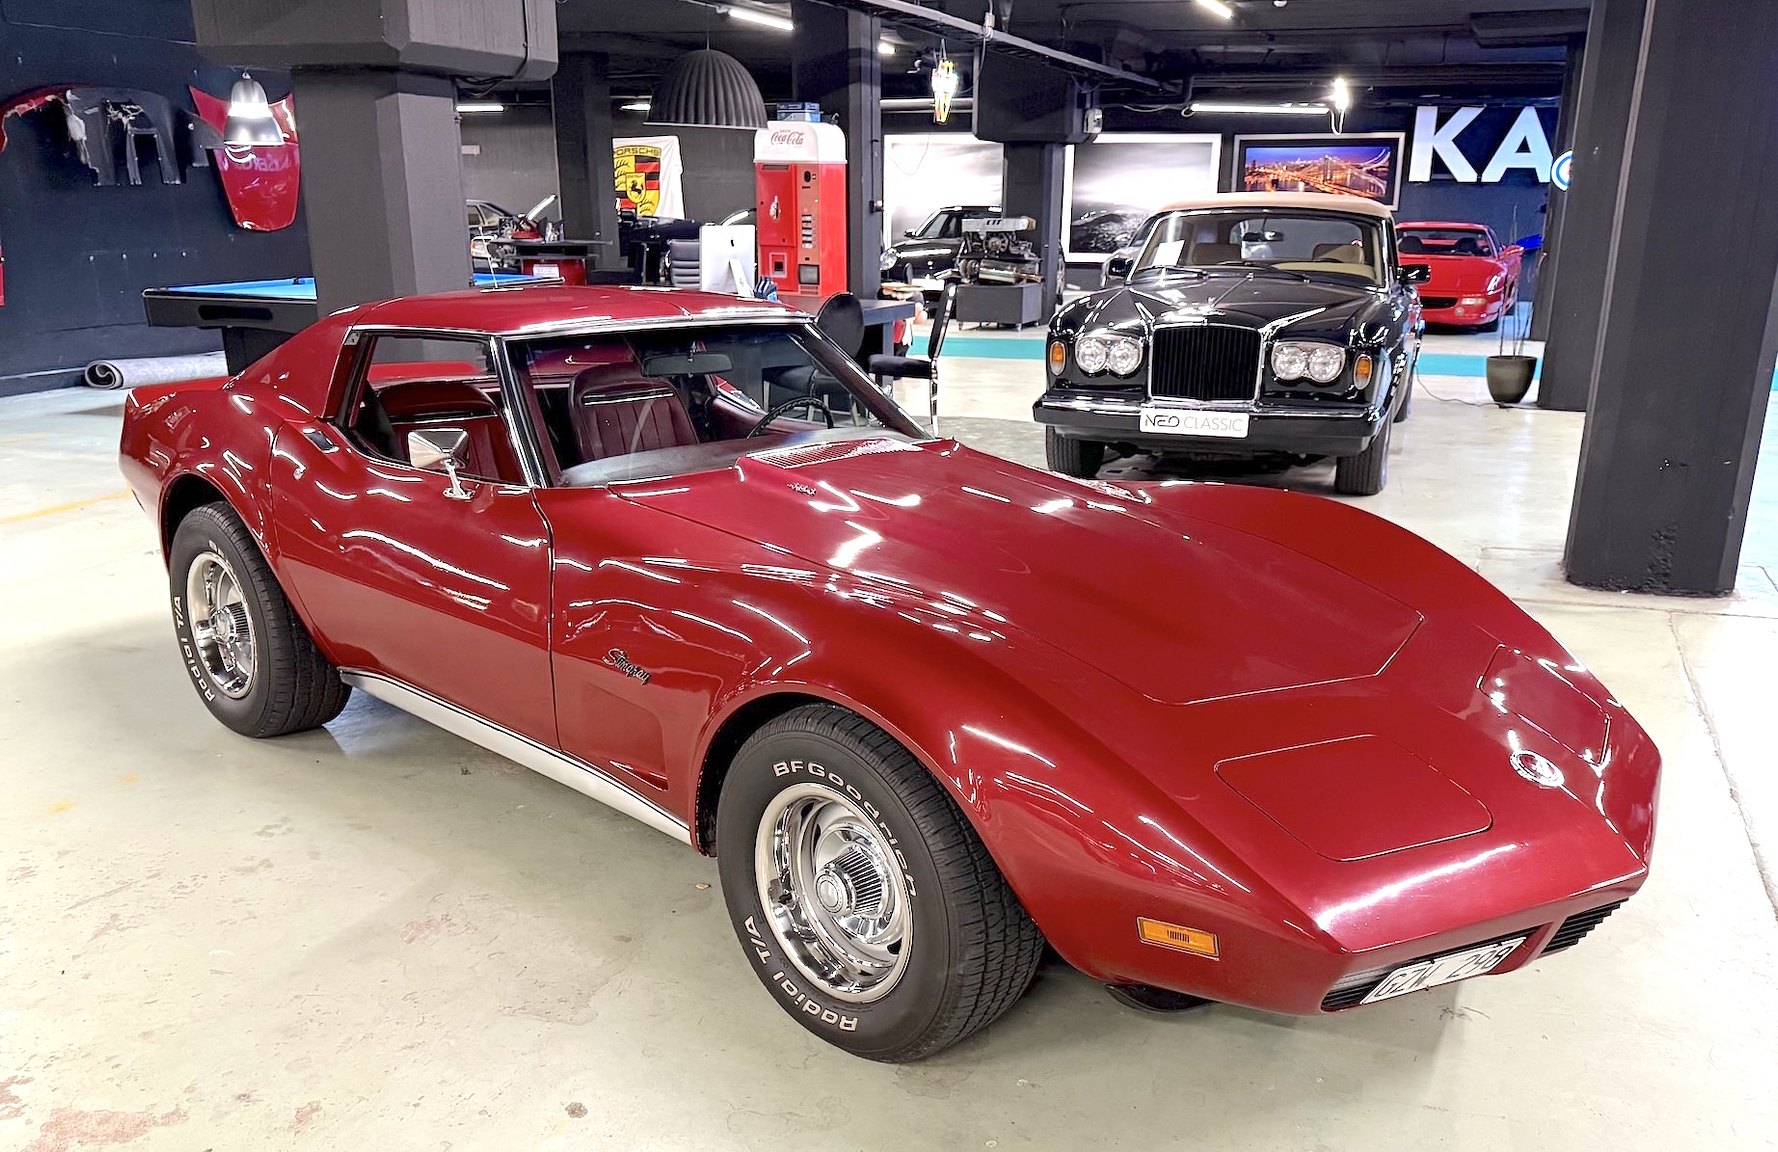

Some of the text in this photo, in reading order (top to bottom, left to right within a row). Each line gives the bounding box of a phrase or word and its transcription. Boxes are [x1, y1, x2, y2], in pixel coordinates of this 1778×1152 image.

[1145, 414, 1243, 431] NEO CLASSIC
[181, 637, 215, 701] Radial
[744, 915, 771, 965] T/A
[772, 971, 858, 1031] Radial
